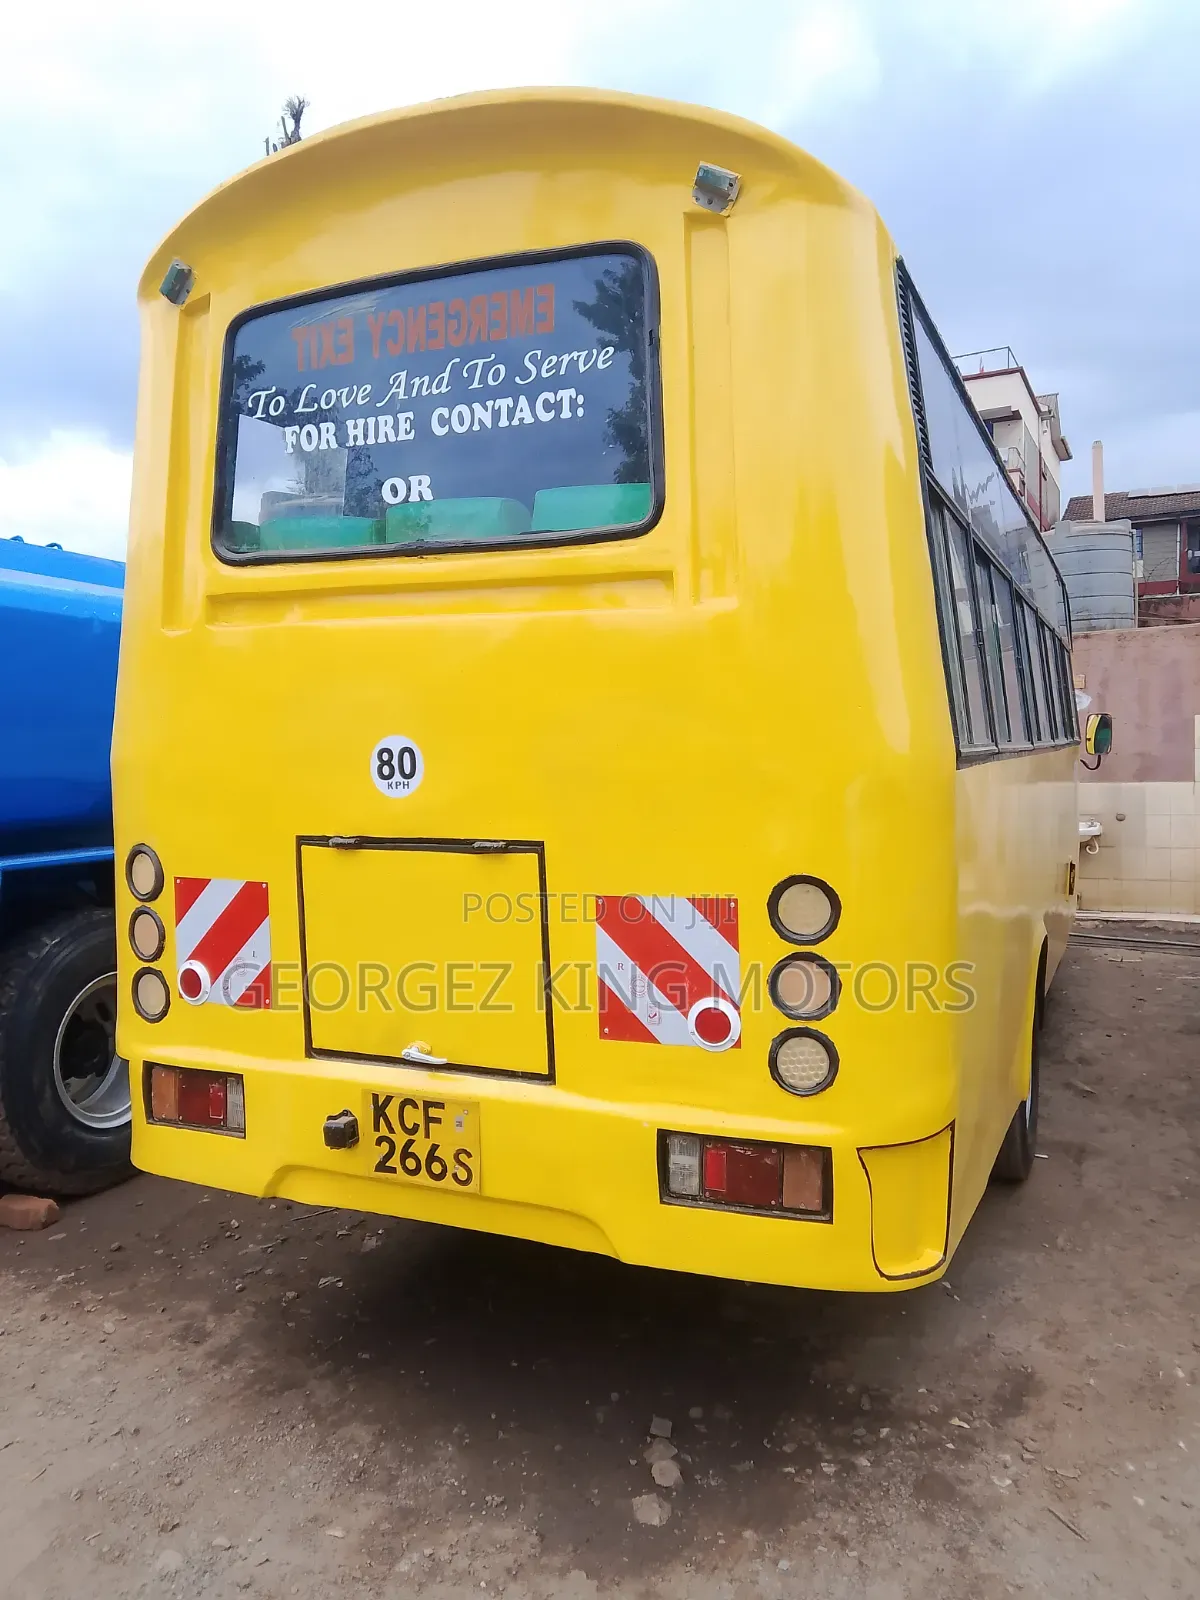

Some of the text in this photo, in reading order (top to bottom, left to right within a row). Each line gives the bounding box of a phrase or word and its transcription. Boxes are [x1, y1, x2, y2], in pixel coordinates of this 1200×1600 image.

[248, 344, 615, 419] To Love And To Serve
[284, 388, 585, 454] FOR HIRE CONTACT:
[381, 475, 433, 505] OR
[376, 746, 417, 781] 80
[387, 780, 410, 790] KPH
[617, 962, 625, 971] R
[371, 1092, 446, 1139] KCF
[374, 1135, 474, 1187] 266S
